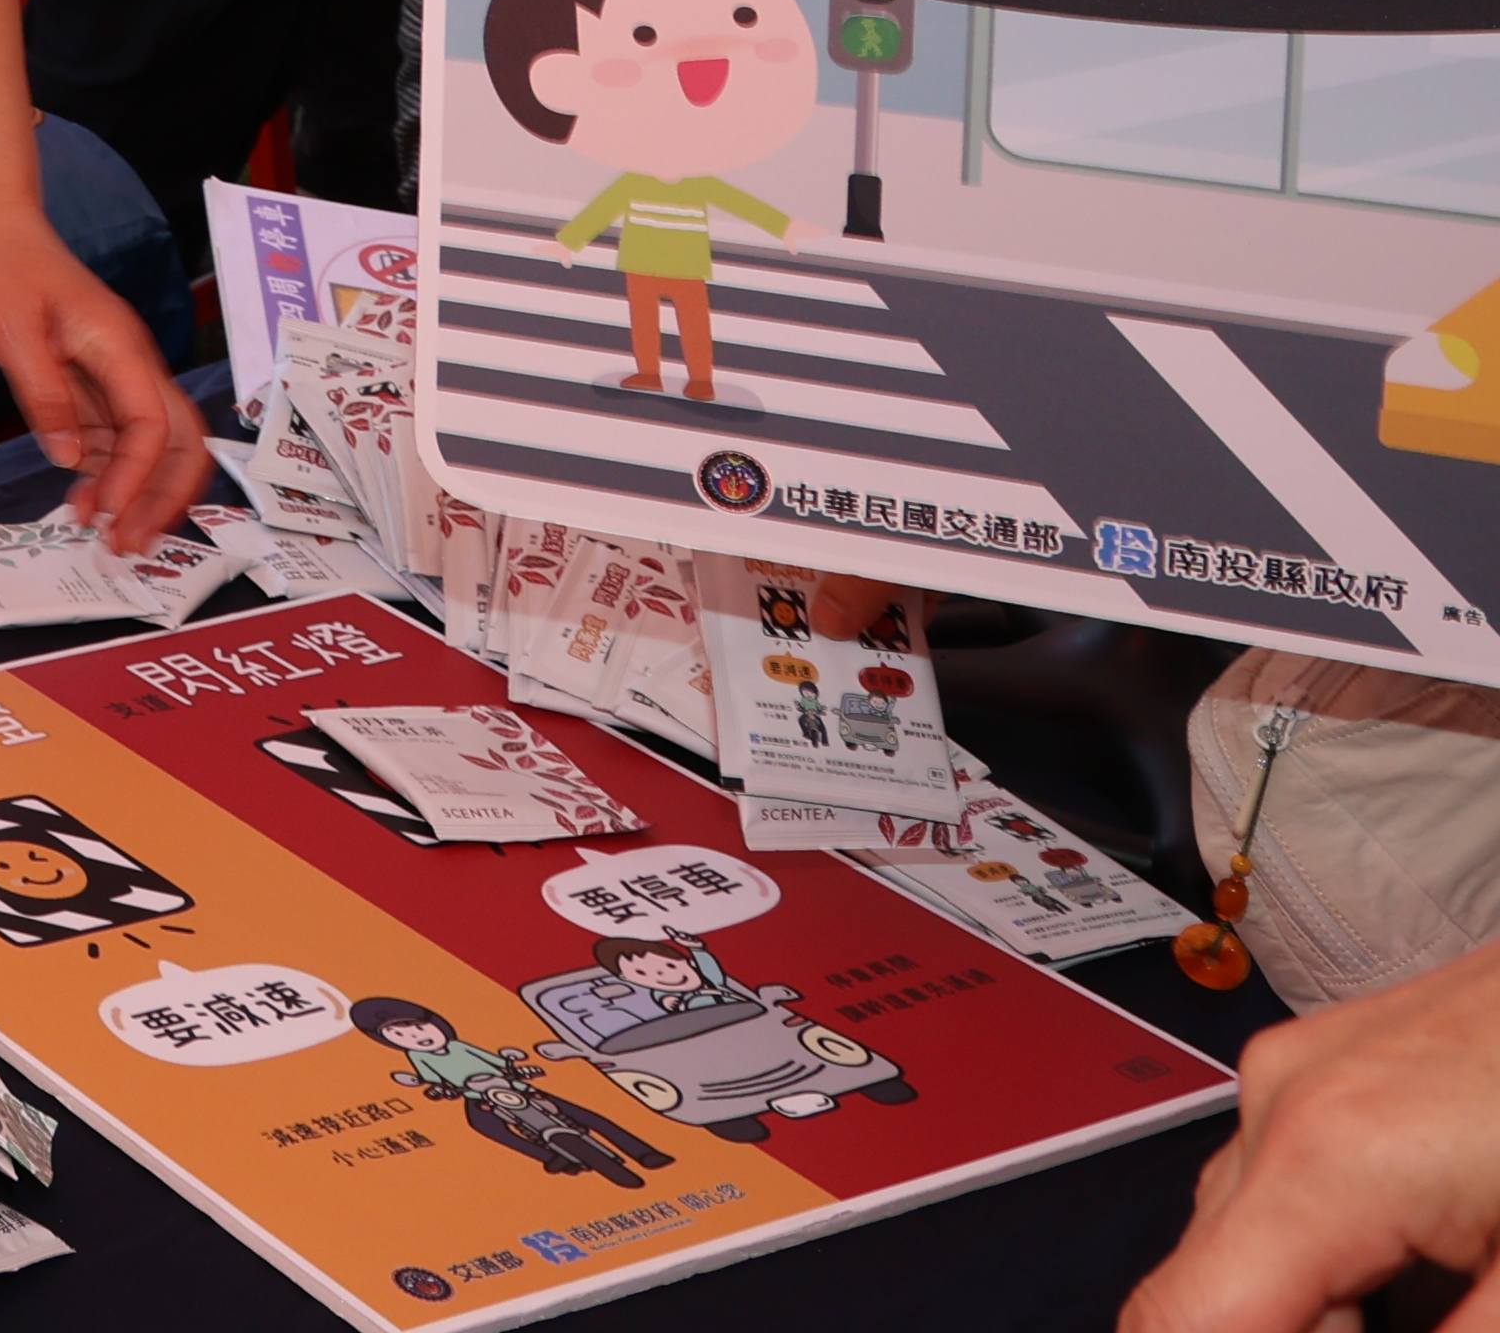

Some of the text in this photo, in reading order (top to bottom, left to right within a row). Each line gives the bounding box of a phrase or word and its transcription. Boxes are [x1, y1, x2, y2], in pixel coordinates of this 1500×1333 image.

[785, 480, 1064, 559] 中華民國交通部
[1165, 539, 1410, 616] 南投縣政府
[1442, 603, 1486, 631] 廣告
[126, 621, 404, 707] 閃紅燈
[442, 807, 515, 820] SCENTEA
[760, 807, 837, 822] SCENTEA
[569, 861, 746, 928] 要停車
[130, 980, 327, 1049] 要減速
[261, 1097, 415, 1149] 減速接近路口
[447, 1249, 525, 1284] 交通部
[566, 1200, 682, 1245] 南投縣政府
